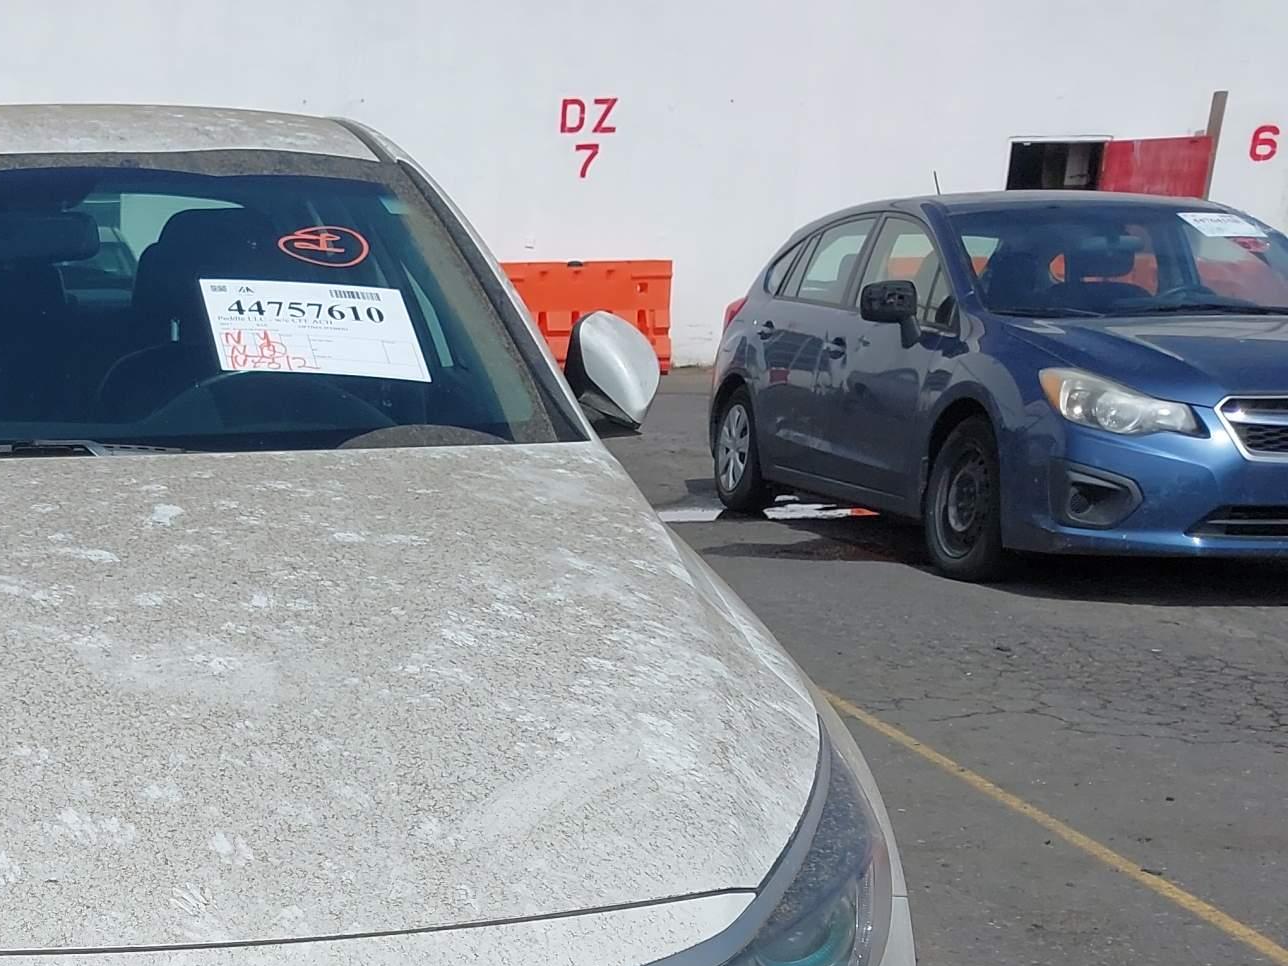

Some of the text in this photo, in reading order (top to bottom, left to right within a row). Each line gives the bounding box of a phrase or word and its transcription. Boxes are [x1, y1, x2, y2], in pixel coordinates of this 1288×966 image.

[560, 98, 618, 133] DZ
[1249, 125, 1281, 161] 6
[575, 144, 599, 178] 7
[228, 300, 384, 324] 44757610
